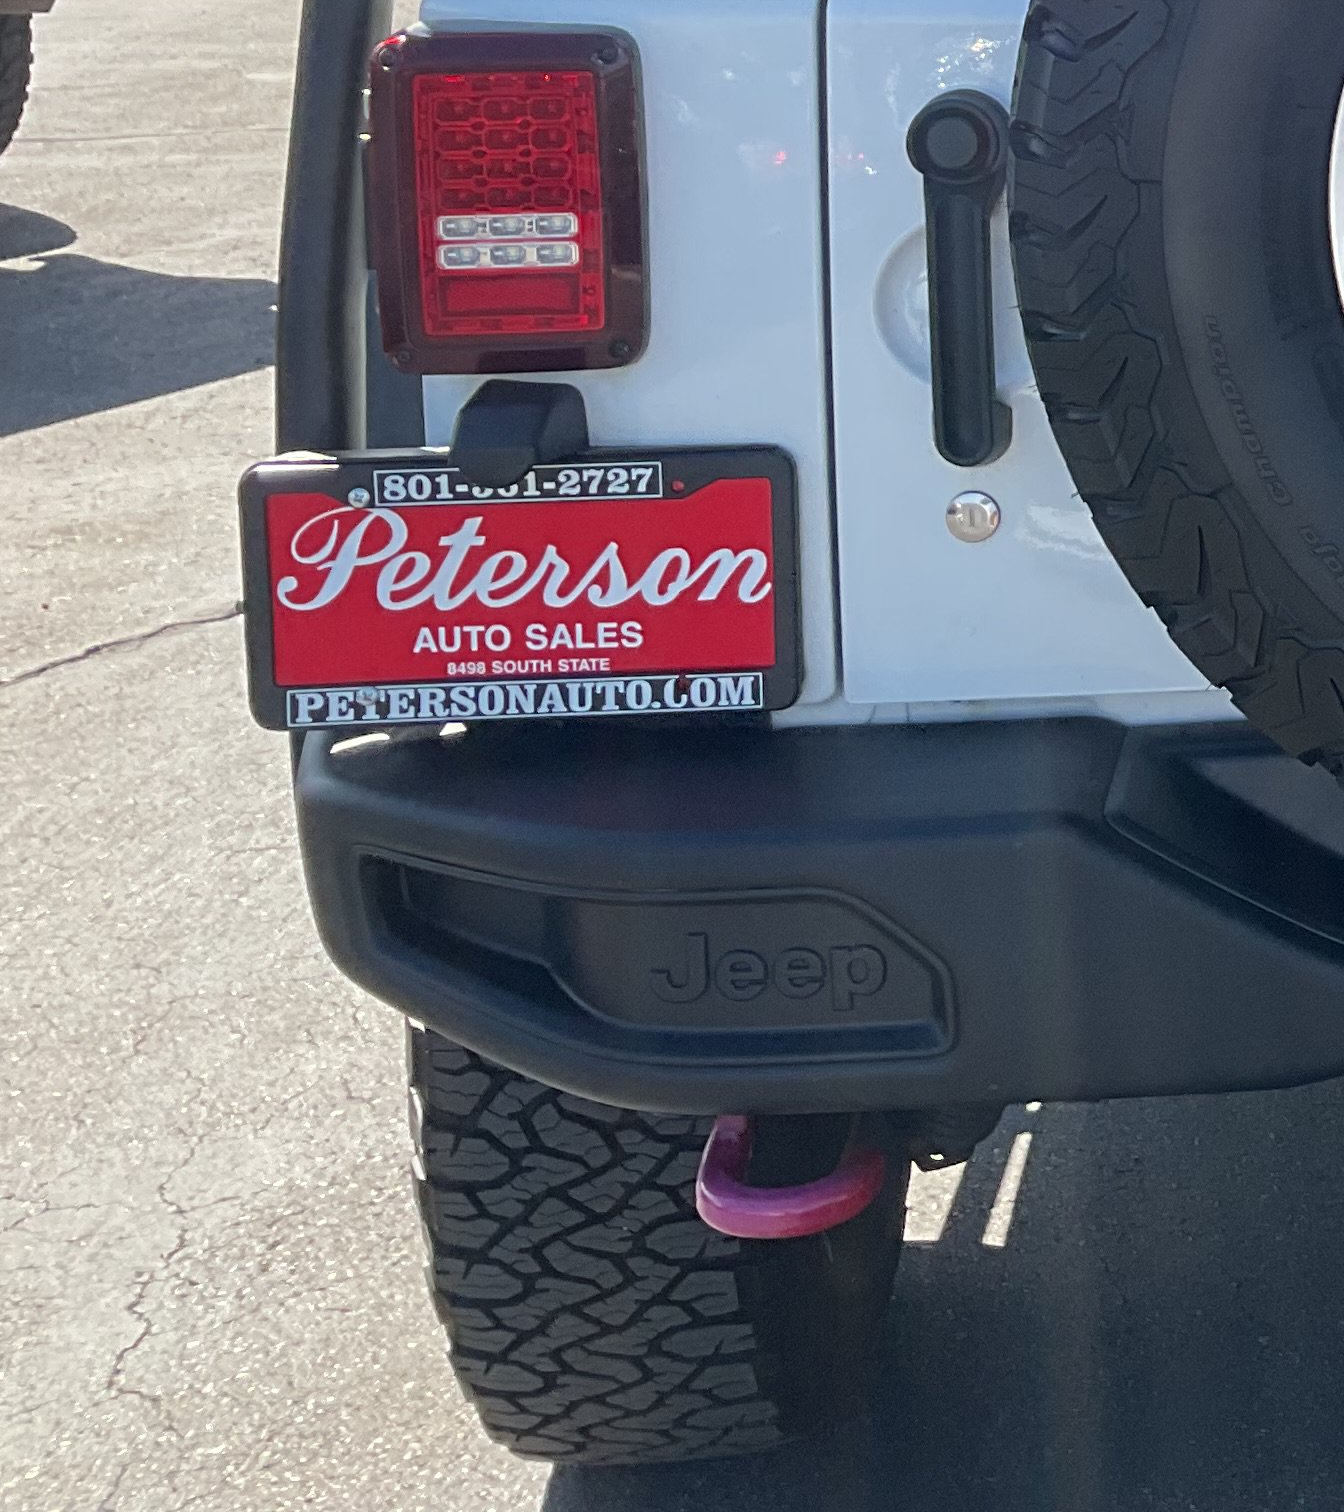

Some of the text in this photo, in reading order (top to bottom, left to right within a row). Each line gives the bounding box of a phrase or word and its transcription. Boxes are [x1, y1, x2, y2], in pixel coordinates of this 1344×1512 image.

[1203, 313, 1294, 508] Champion
[276, 505, 772, 611] Peterson
[413, 621, 644, 654] AUTO SALES
[447, 657, 611, 675] 8498 SOUTH STATE
[651, 930, 887, 1012] Jeep
